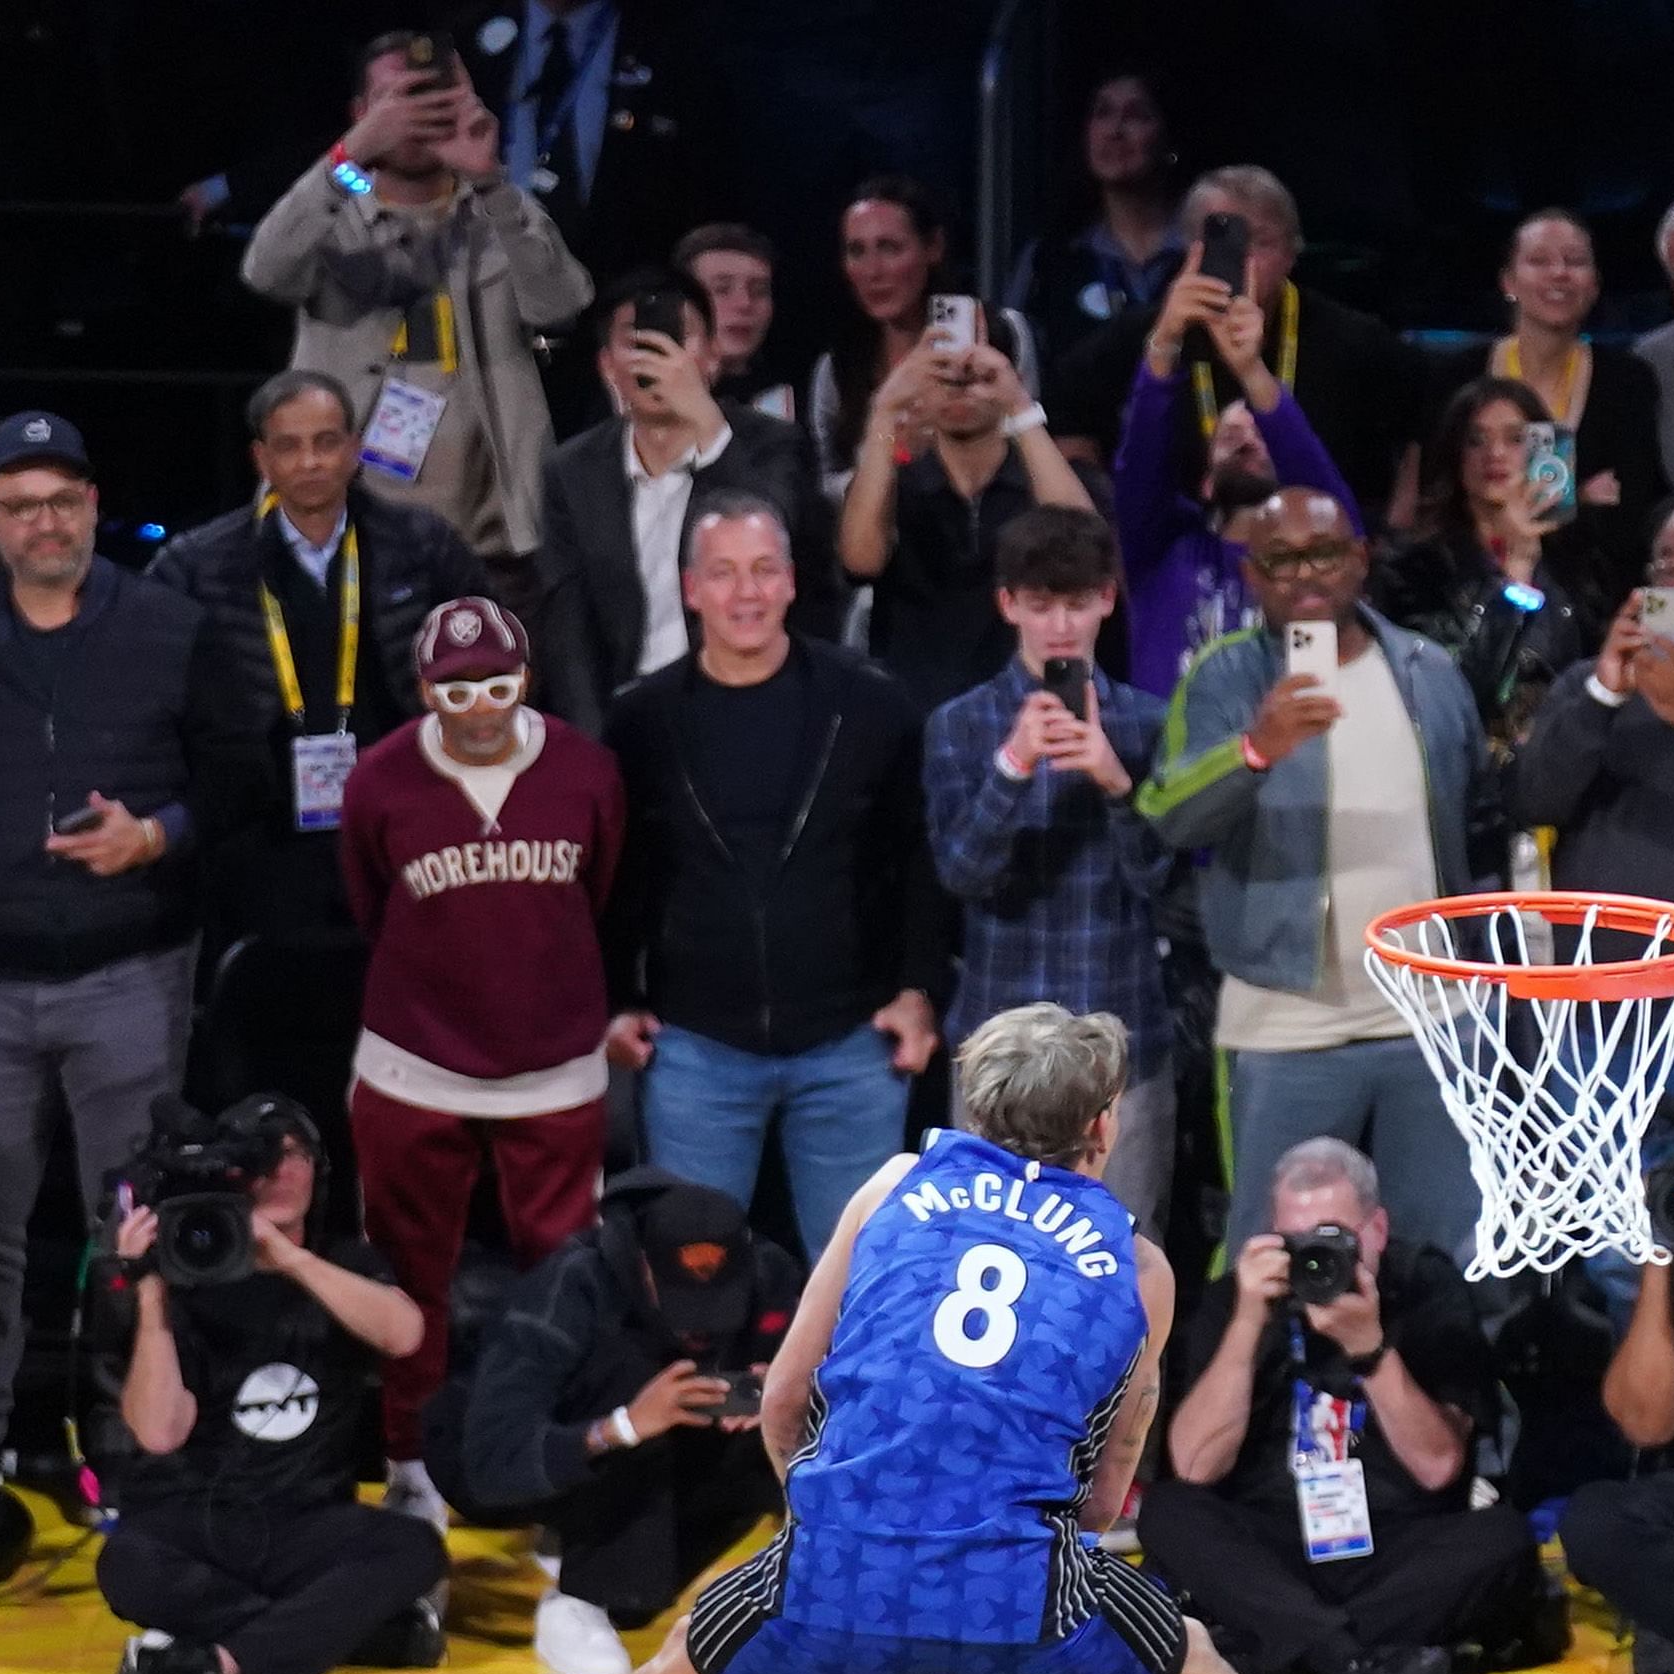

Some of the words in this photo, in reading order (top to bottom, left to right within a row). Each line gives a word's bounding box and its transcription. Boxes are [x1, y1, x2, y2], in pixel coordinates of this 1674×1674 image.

[402, 838, 583, 900] MOREHOUSE
[901, 1171, 1120, 1279] McCLUNG
[933, 1242, 1029, 1369] 8
